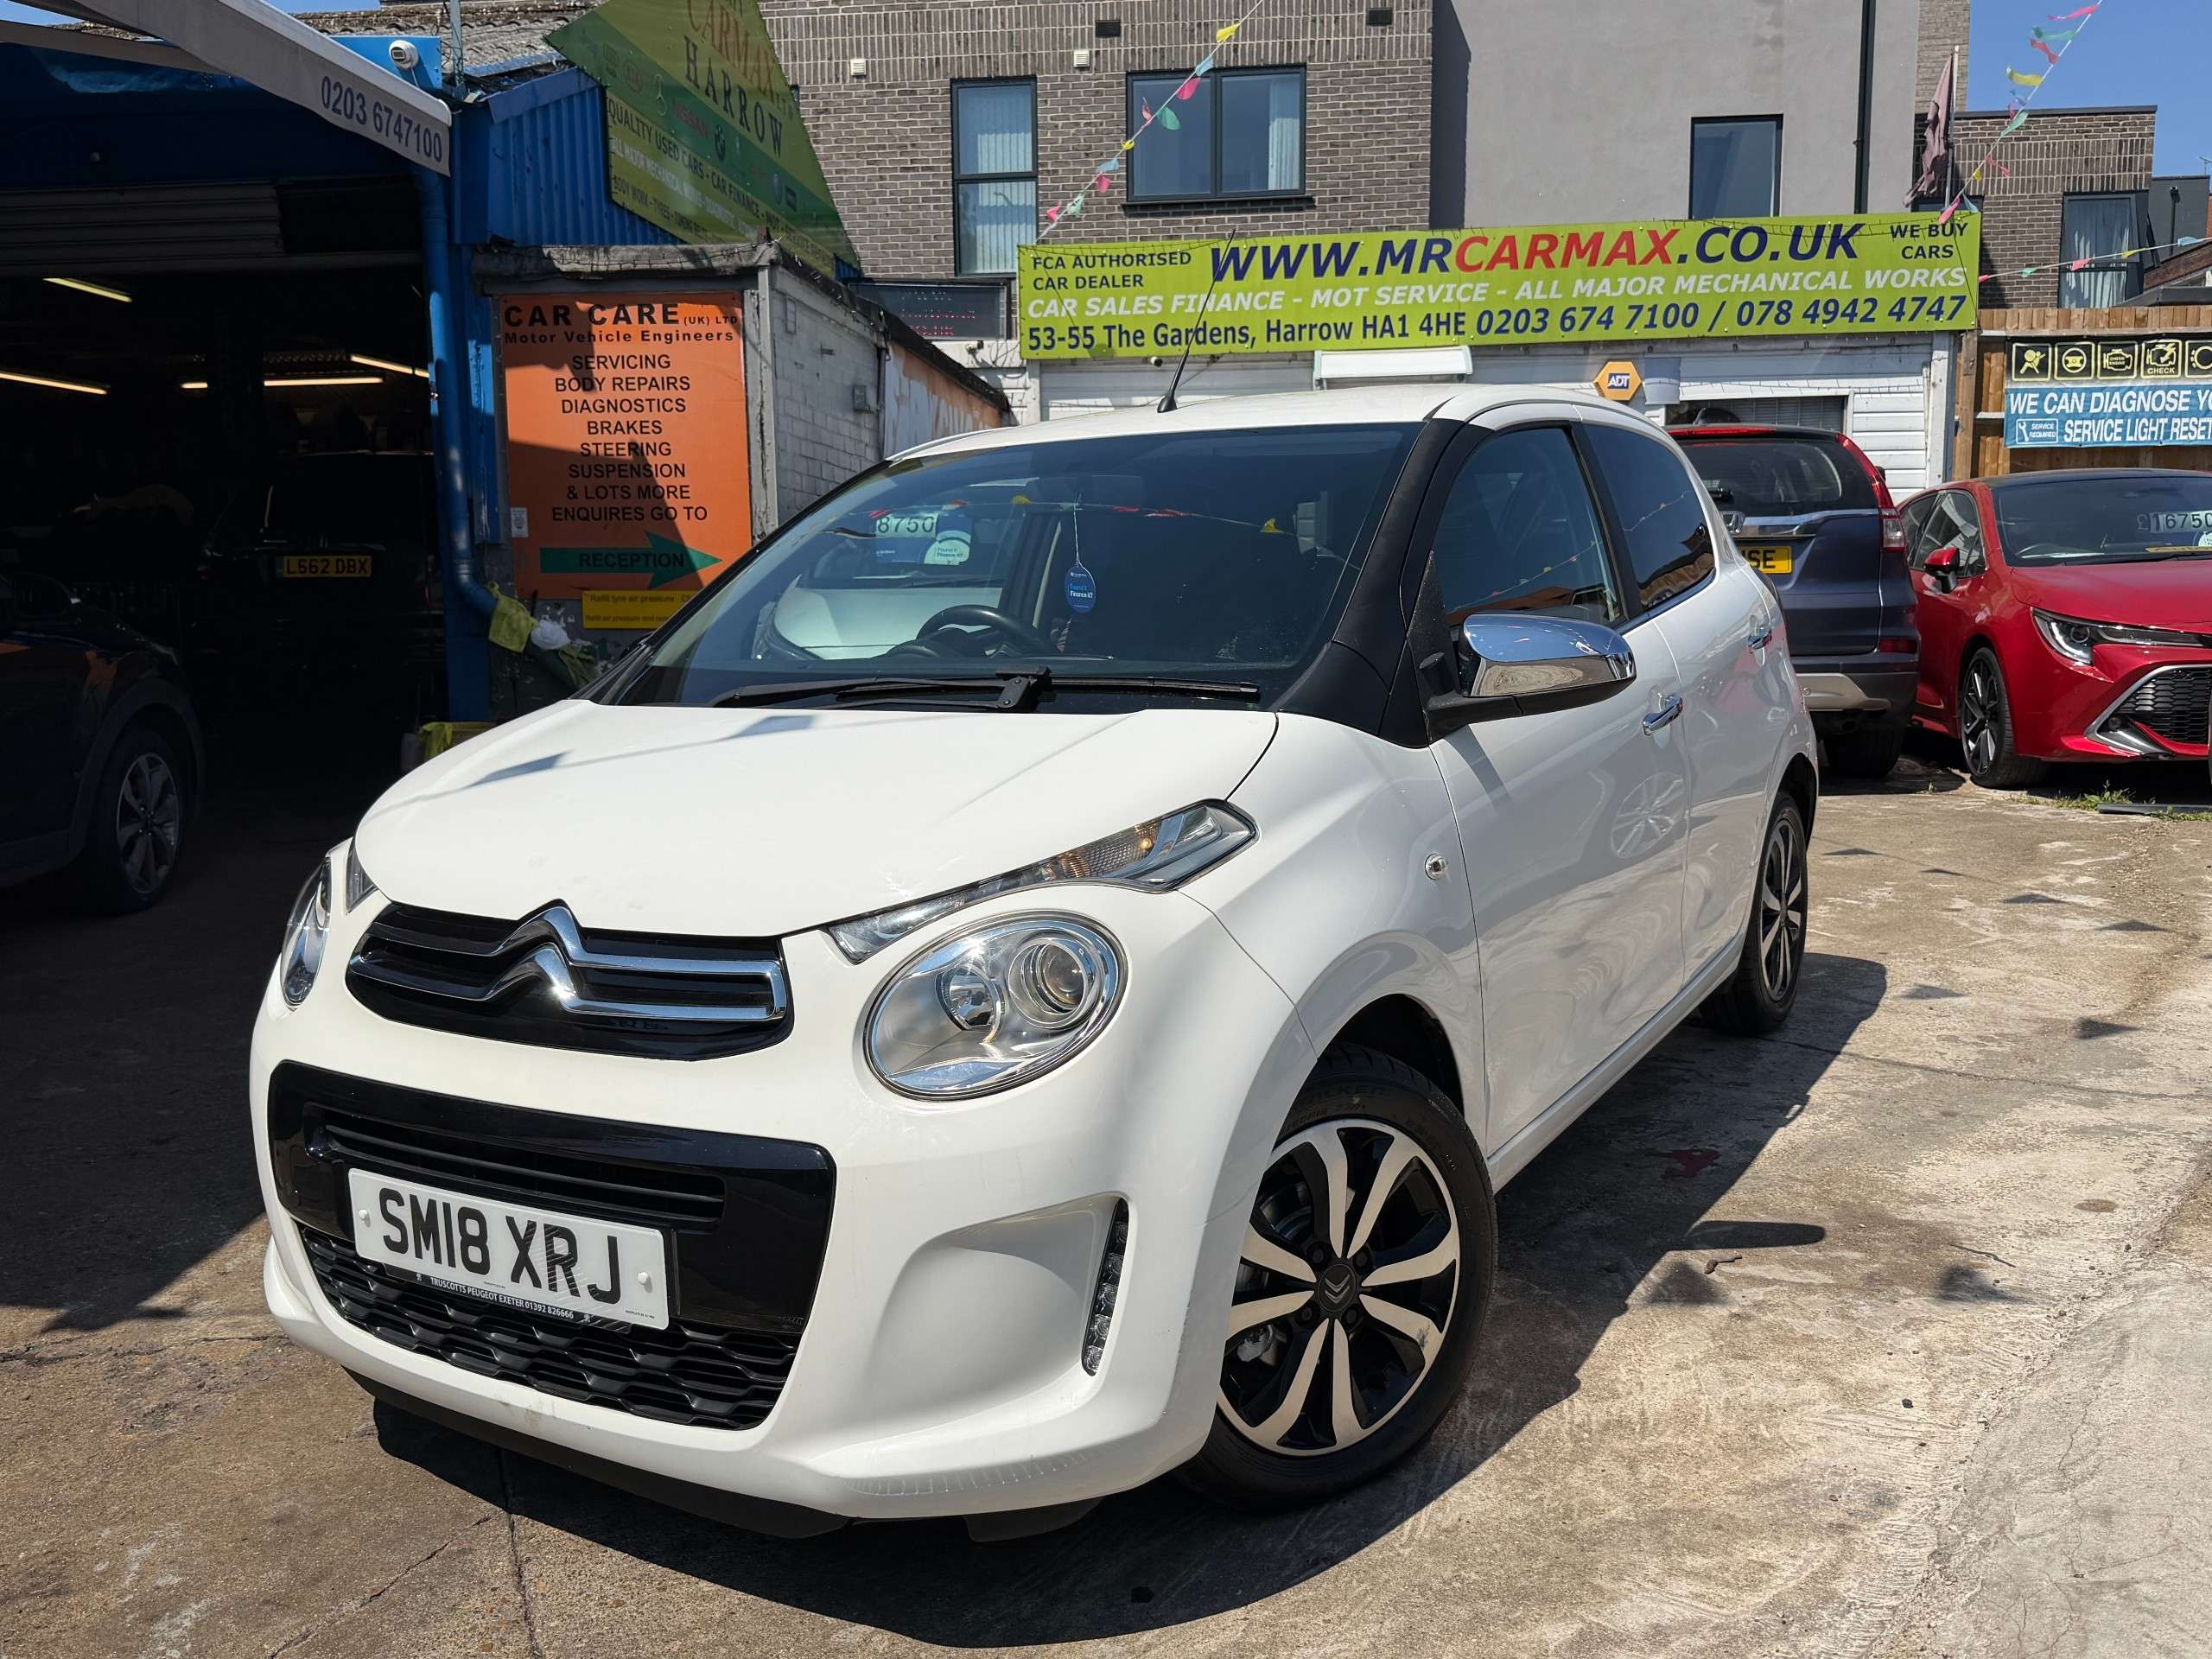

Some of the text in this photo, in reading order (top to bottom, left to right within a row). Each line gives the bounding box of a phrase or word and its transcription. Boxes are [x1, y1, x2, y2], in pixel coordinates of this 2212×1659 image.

[684, 35, 782, 157] HARROW
[321, 75, 442, 162] 0203 6747100
[608, 98, 652, 143] QUALITY
[655, 130, 680, 161] USED
[681, 152, 704, 180] CARS
[1891, 222, 1968, 238] WE BUY
[1033, 251, 1192, 270] FCA AUTHORISED
[1901, 245, 1954, 259] CARS
[1033, 274, 1145, 290] CAR DEALER
[1027, 298, 1077, 319] CAR
[1084, 295, 1163, 316] SALES
[1171, 290, 1285, 315] FINANCE
[1311, 288, 1369, 308] MOT
[1375, 283, 1490, 305] SERVICE
[1514, 280, 1563, 300] ALL
[1572, 276, 1665, 298] MAJOR
[1673, 270, 1853, 294] MECHANICAL
[1865, 267, 1967, 289] WORKS
[504, 303, 738, 327] CAR CARE (UK) LTD
[1028, 296, 1967, 351] 53-55 The Gardens, Harrow HA1 4HE 0203 674 7100 / 078 4942 4747
[505, 329, 734, 344] Motor Vehicle Engineers
[572, 354, 671, 370] SERVICING
[555, 376, 691, 392] BODY REPAIRS
[1607, 374, 1630, 388] ADT
[562, 397, 686, 414] DIAGNOSTICS
[2010, 392, 2038, 415] WE
[2044, 391, 2085, 414] CAN
[2089, 390, 2192, 414] DIAGNOSE
[587, 420, 663, 435] BRAKES
[2063, 419, 2123, 442] SERVICE
[2126, 417, 2167, 442] LIGHT
[580, 442, 671, 457] STEERING
[569, 463, 685, 479] SUSPENSION
[567, 485, 690, 499] & LOTS MORE
[552, 505, 708, 521] ENQUIRES GO TO
[877, 516, 935, 533] 8750
[286, 558, 368, 575] LS62 DBX
[580, 552, 685, 568] RECEPTION
[1741, 550, 1777, 569] SE
[378, 1187, 620, 1305] SM18 XRJ
[430, 1276, 467, 1294] TRUSCOTTS
[467, 1286, 499, 1303] PEUGEOT
[499, 1294, 525, 1309] EXETER
[525, 1300, 547, 1314] 01392
[547, 1306, 574, 1319] 826666
